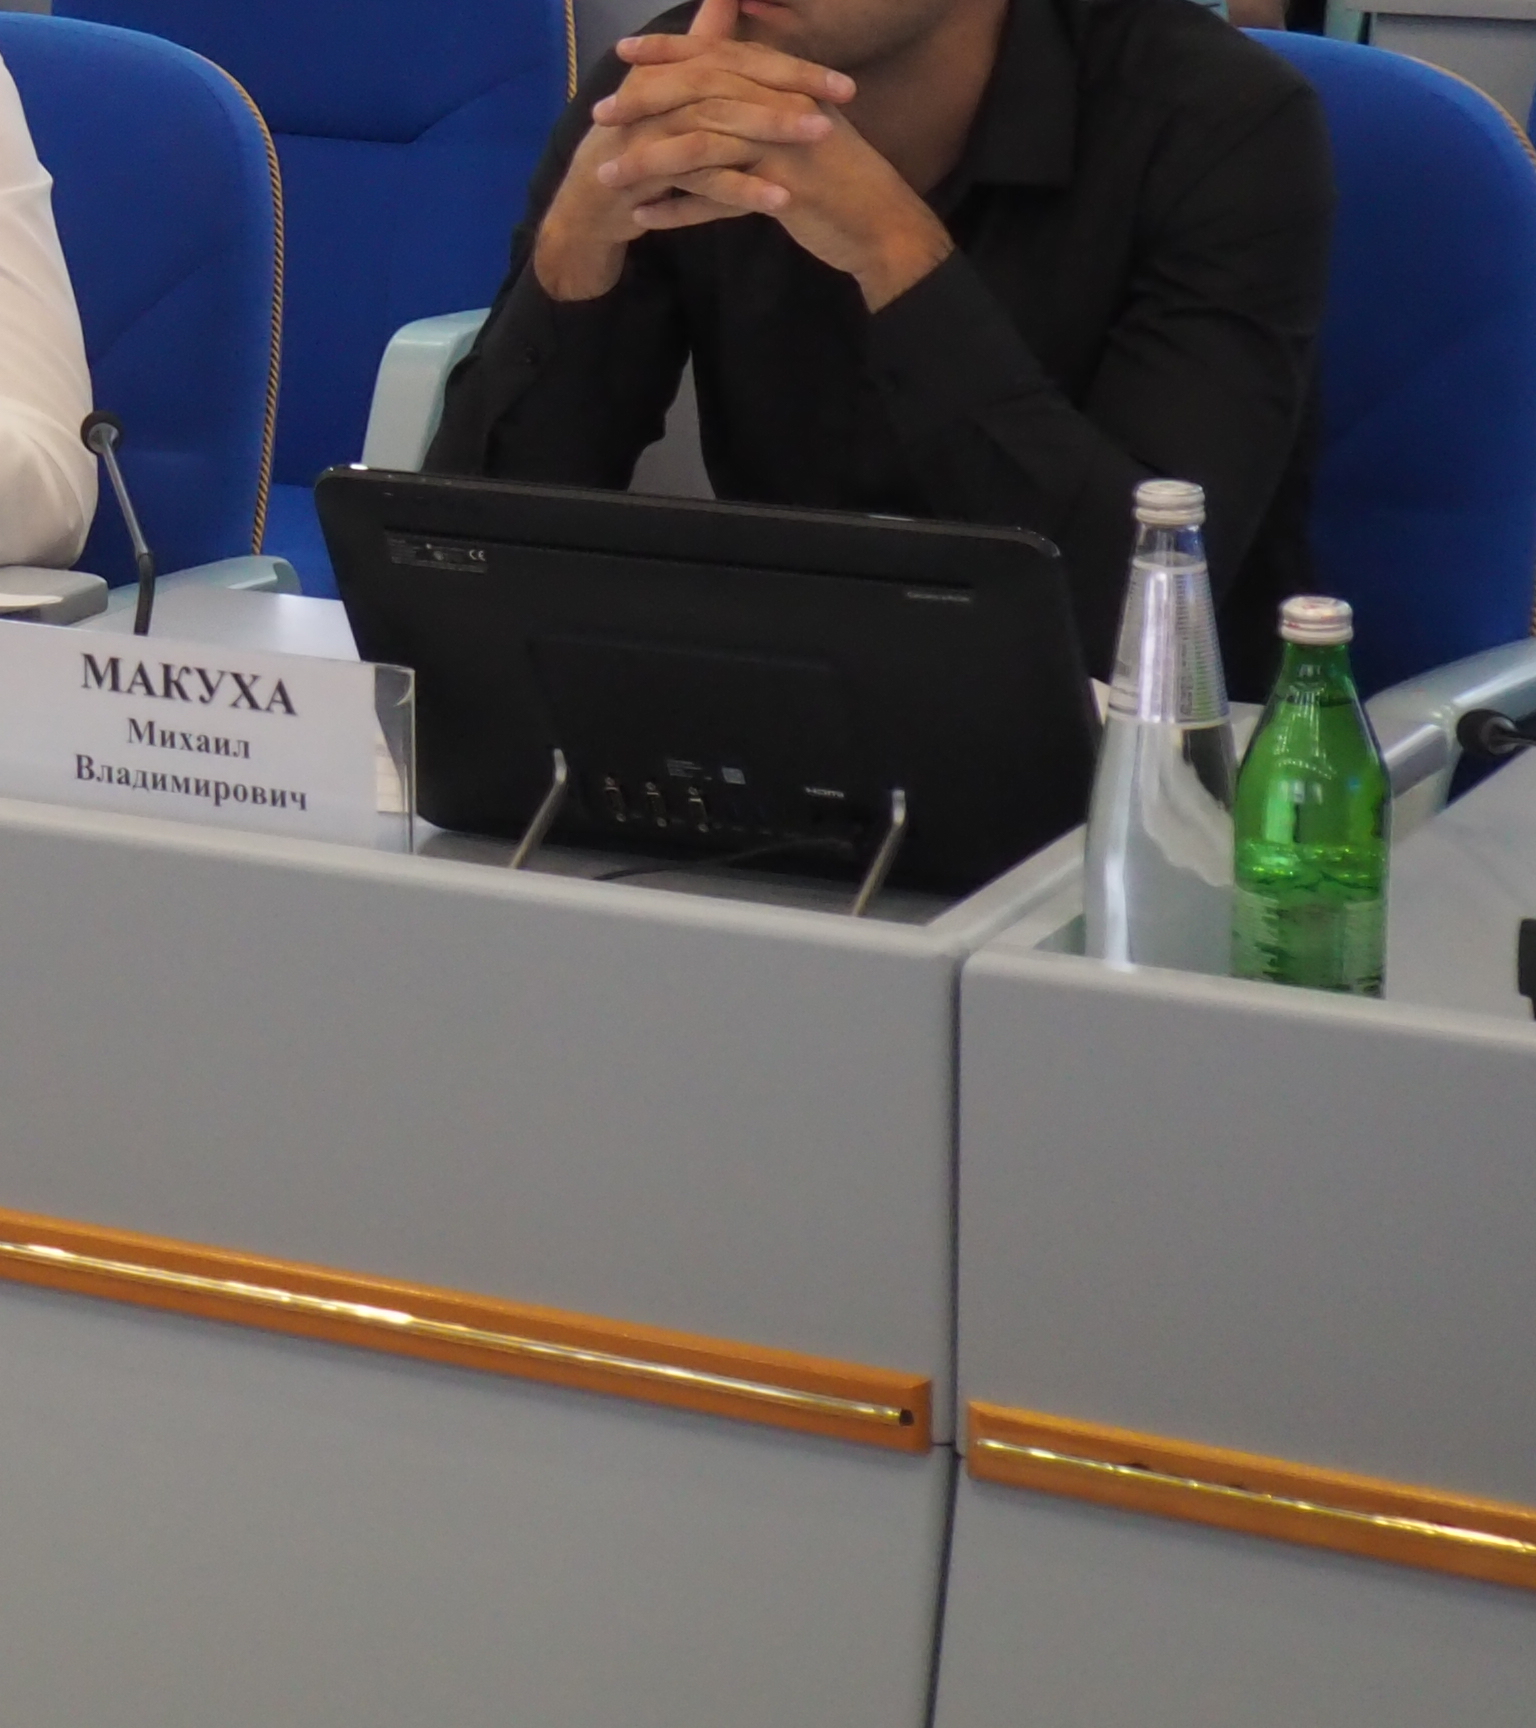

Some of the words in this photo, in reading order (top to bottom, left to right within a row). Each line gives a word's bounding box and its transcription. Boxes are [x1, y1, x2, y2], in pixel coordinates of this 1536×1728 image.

[81, 652, 299, 717] МАКУХА
[126, 717, 251, 760] Михаил
[74, 753, 308, 812] Владимирович
